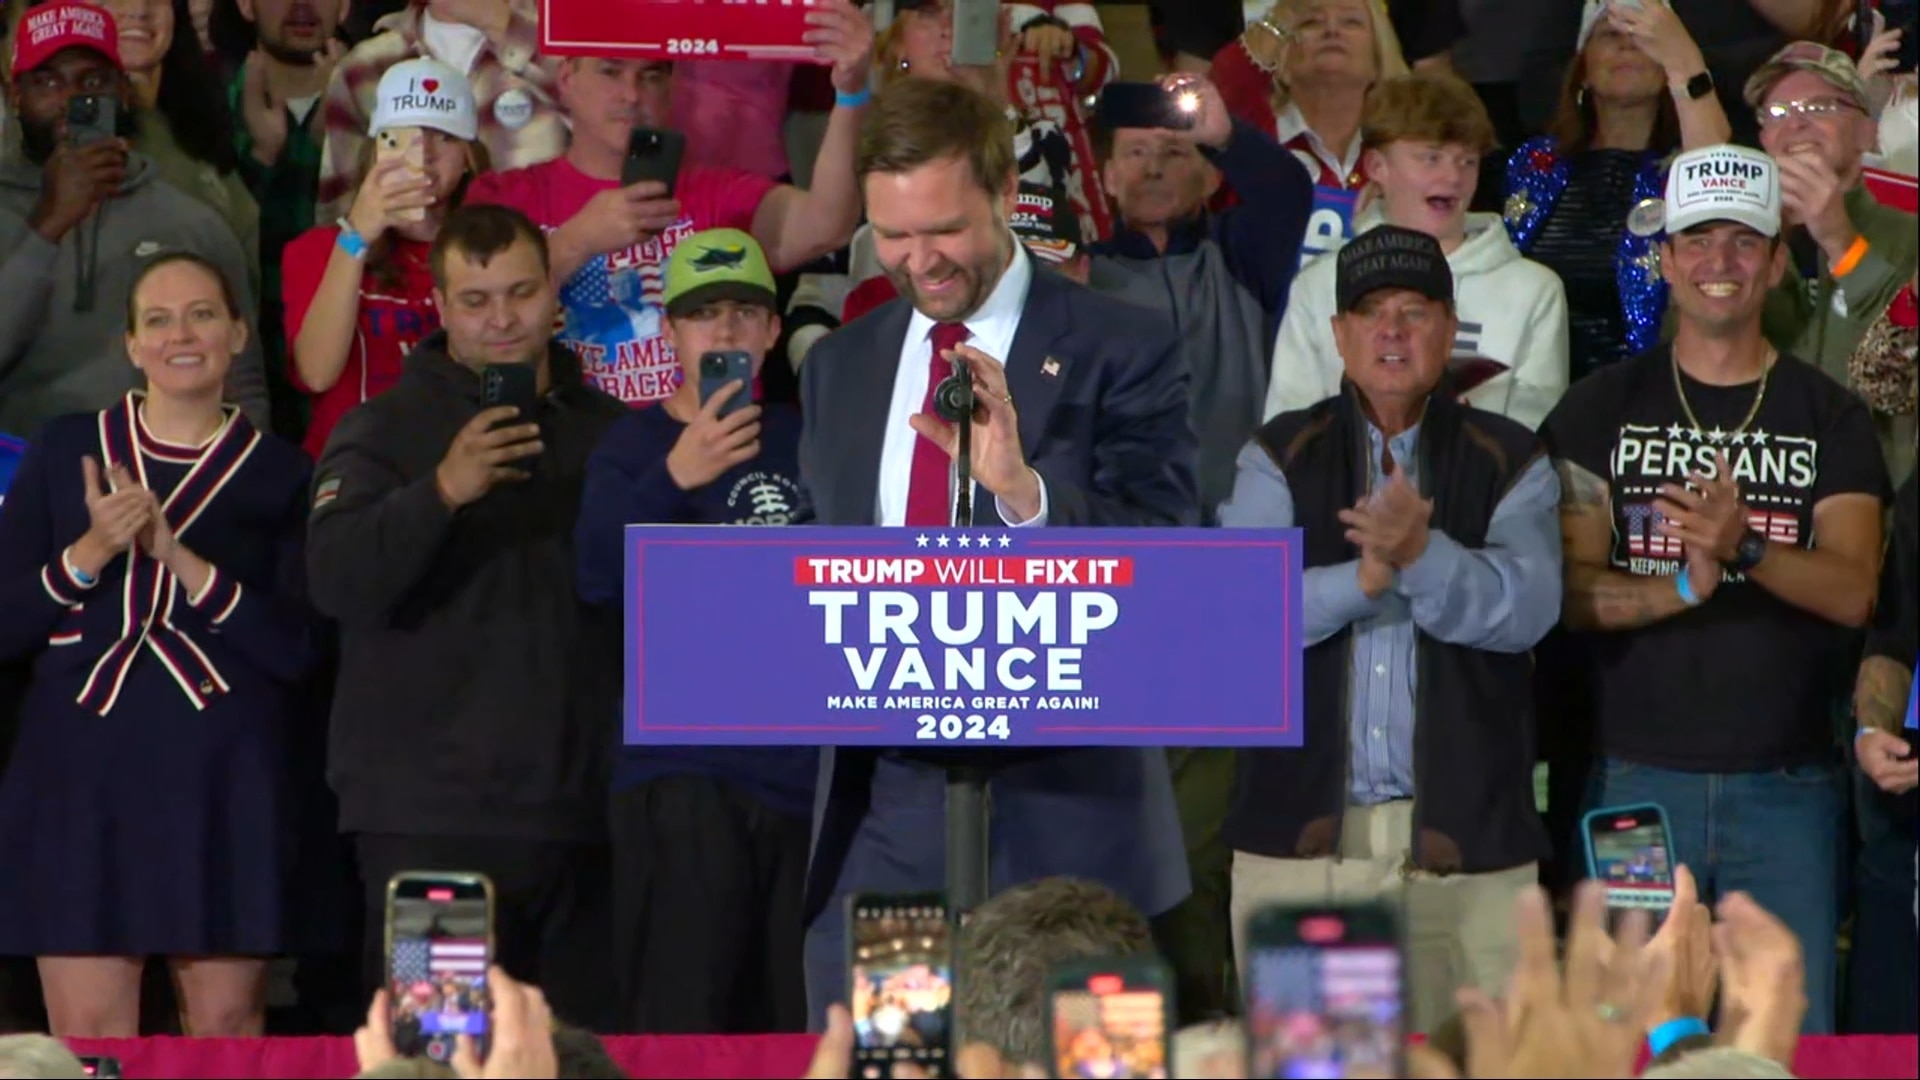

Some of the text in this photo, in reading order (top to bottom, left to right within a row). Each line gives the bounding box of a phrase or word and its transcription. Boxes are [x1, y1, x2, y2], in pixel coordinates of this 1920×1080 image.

[32, 22, 66, 45] GREAT
[666, 39, 719, 54] 2024
[409, 78, 415, 93] I
[392, 94, 457, 112] TRUMP
[1685, 160, 1763, 181] TRUMP
[1701, 178, 1747, 189] VANCE
[1016, 193, 1054, 211] ump
[1010, 212, 1038, 222] 024
[606, 226, 694, 269] FIGH
[727, 471, 768, 508] COUNCIL
[809, 559, 1119, 584] TRUMP WILL FIX IT
[809, 591, 1119, 645] TRUMP
[843, 647, 1083, 691] VANCE
[827, 696, 1100, 710] MAKE AMERICA GREAT AGAIN!
[916, 714, 1011, 740] 2024
